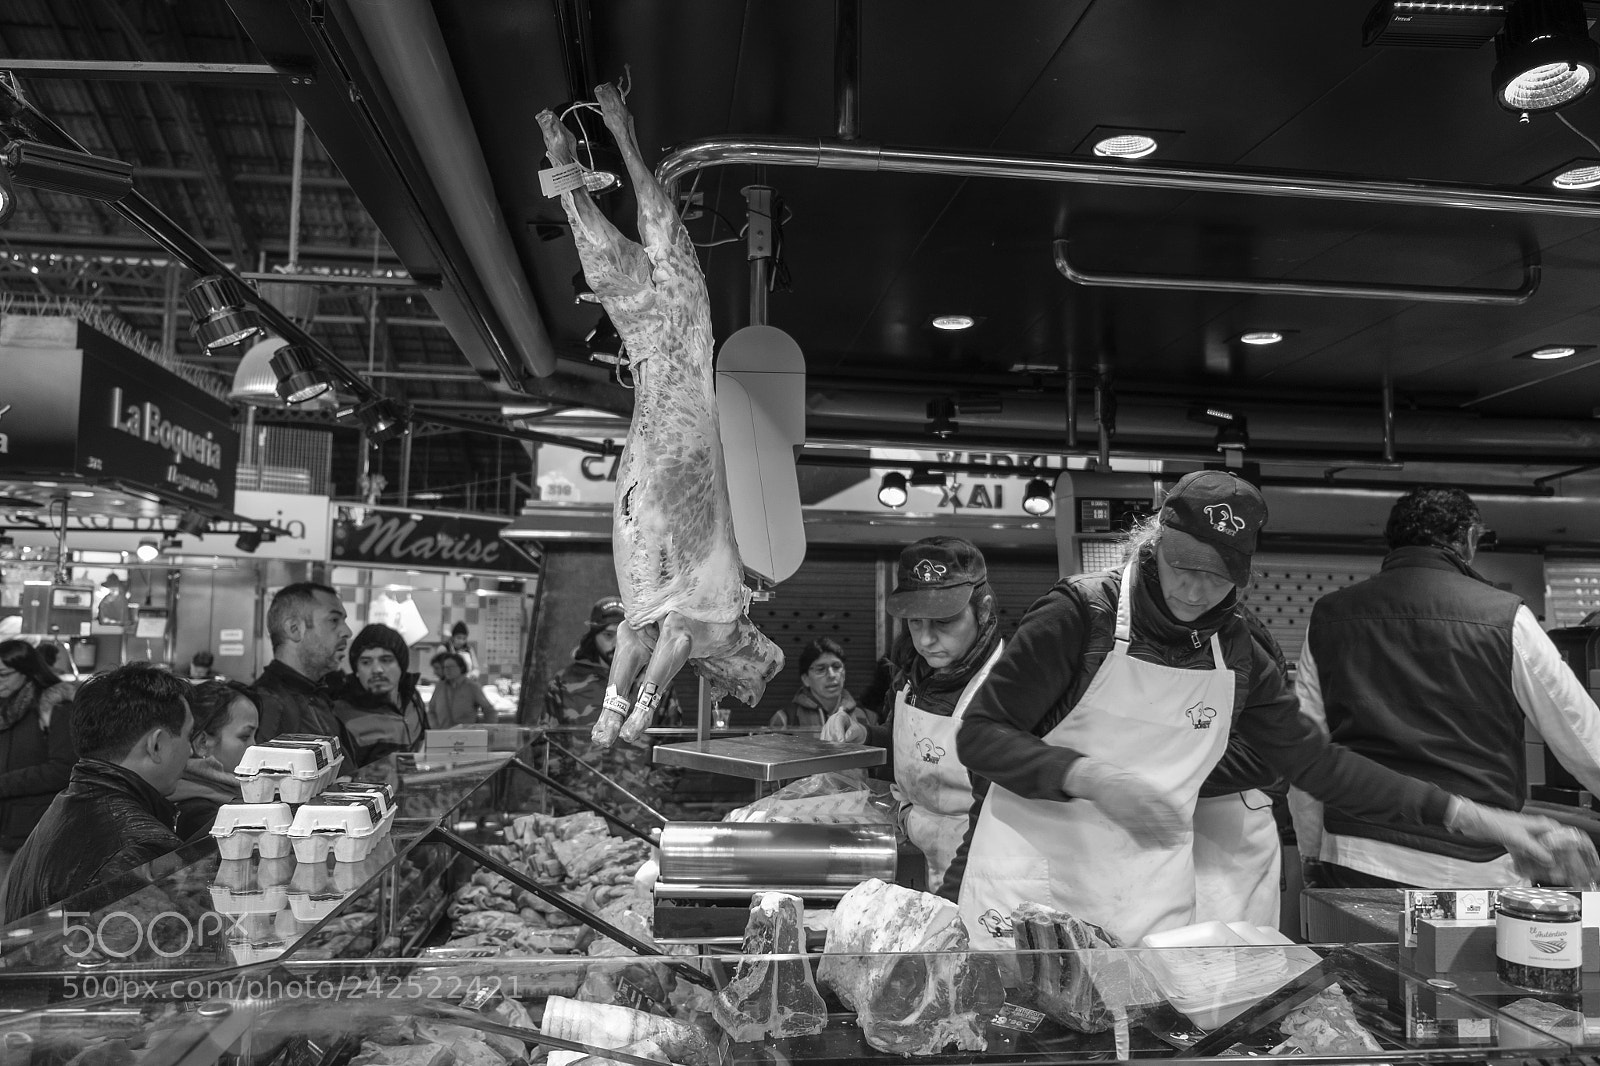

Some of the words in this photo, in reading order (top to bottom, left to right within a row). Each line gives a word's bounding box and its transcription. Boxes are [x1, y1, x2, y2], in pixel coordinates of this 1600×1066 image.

[111, 386, 141, 437] La
[143, 401, 222, 470] Boqueria
[937, 483, 1003, 509] XAI
[357, 514, 501, 563] Marisc
